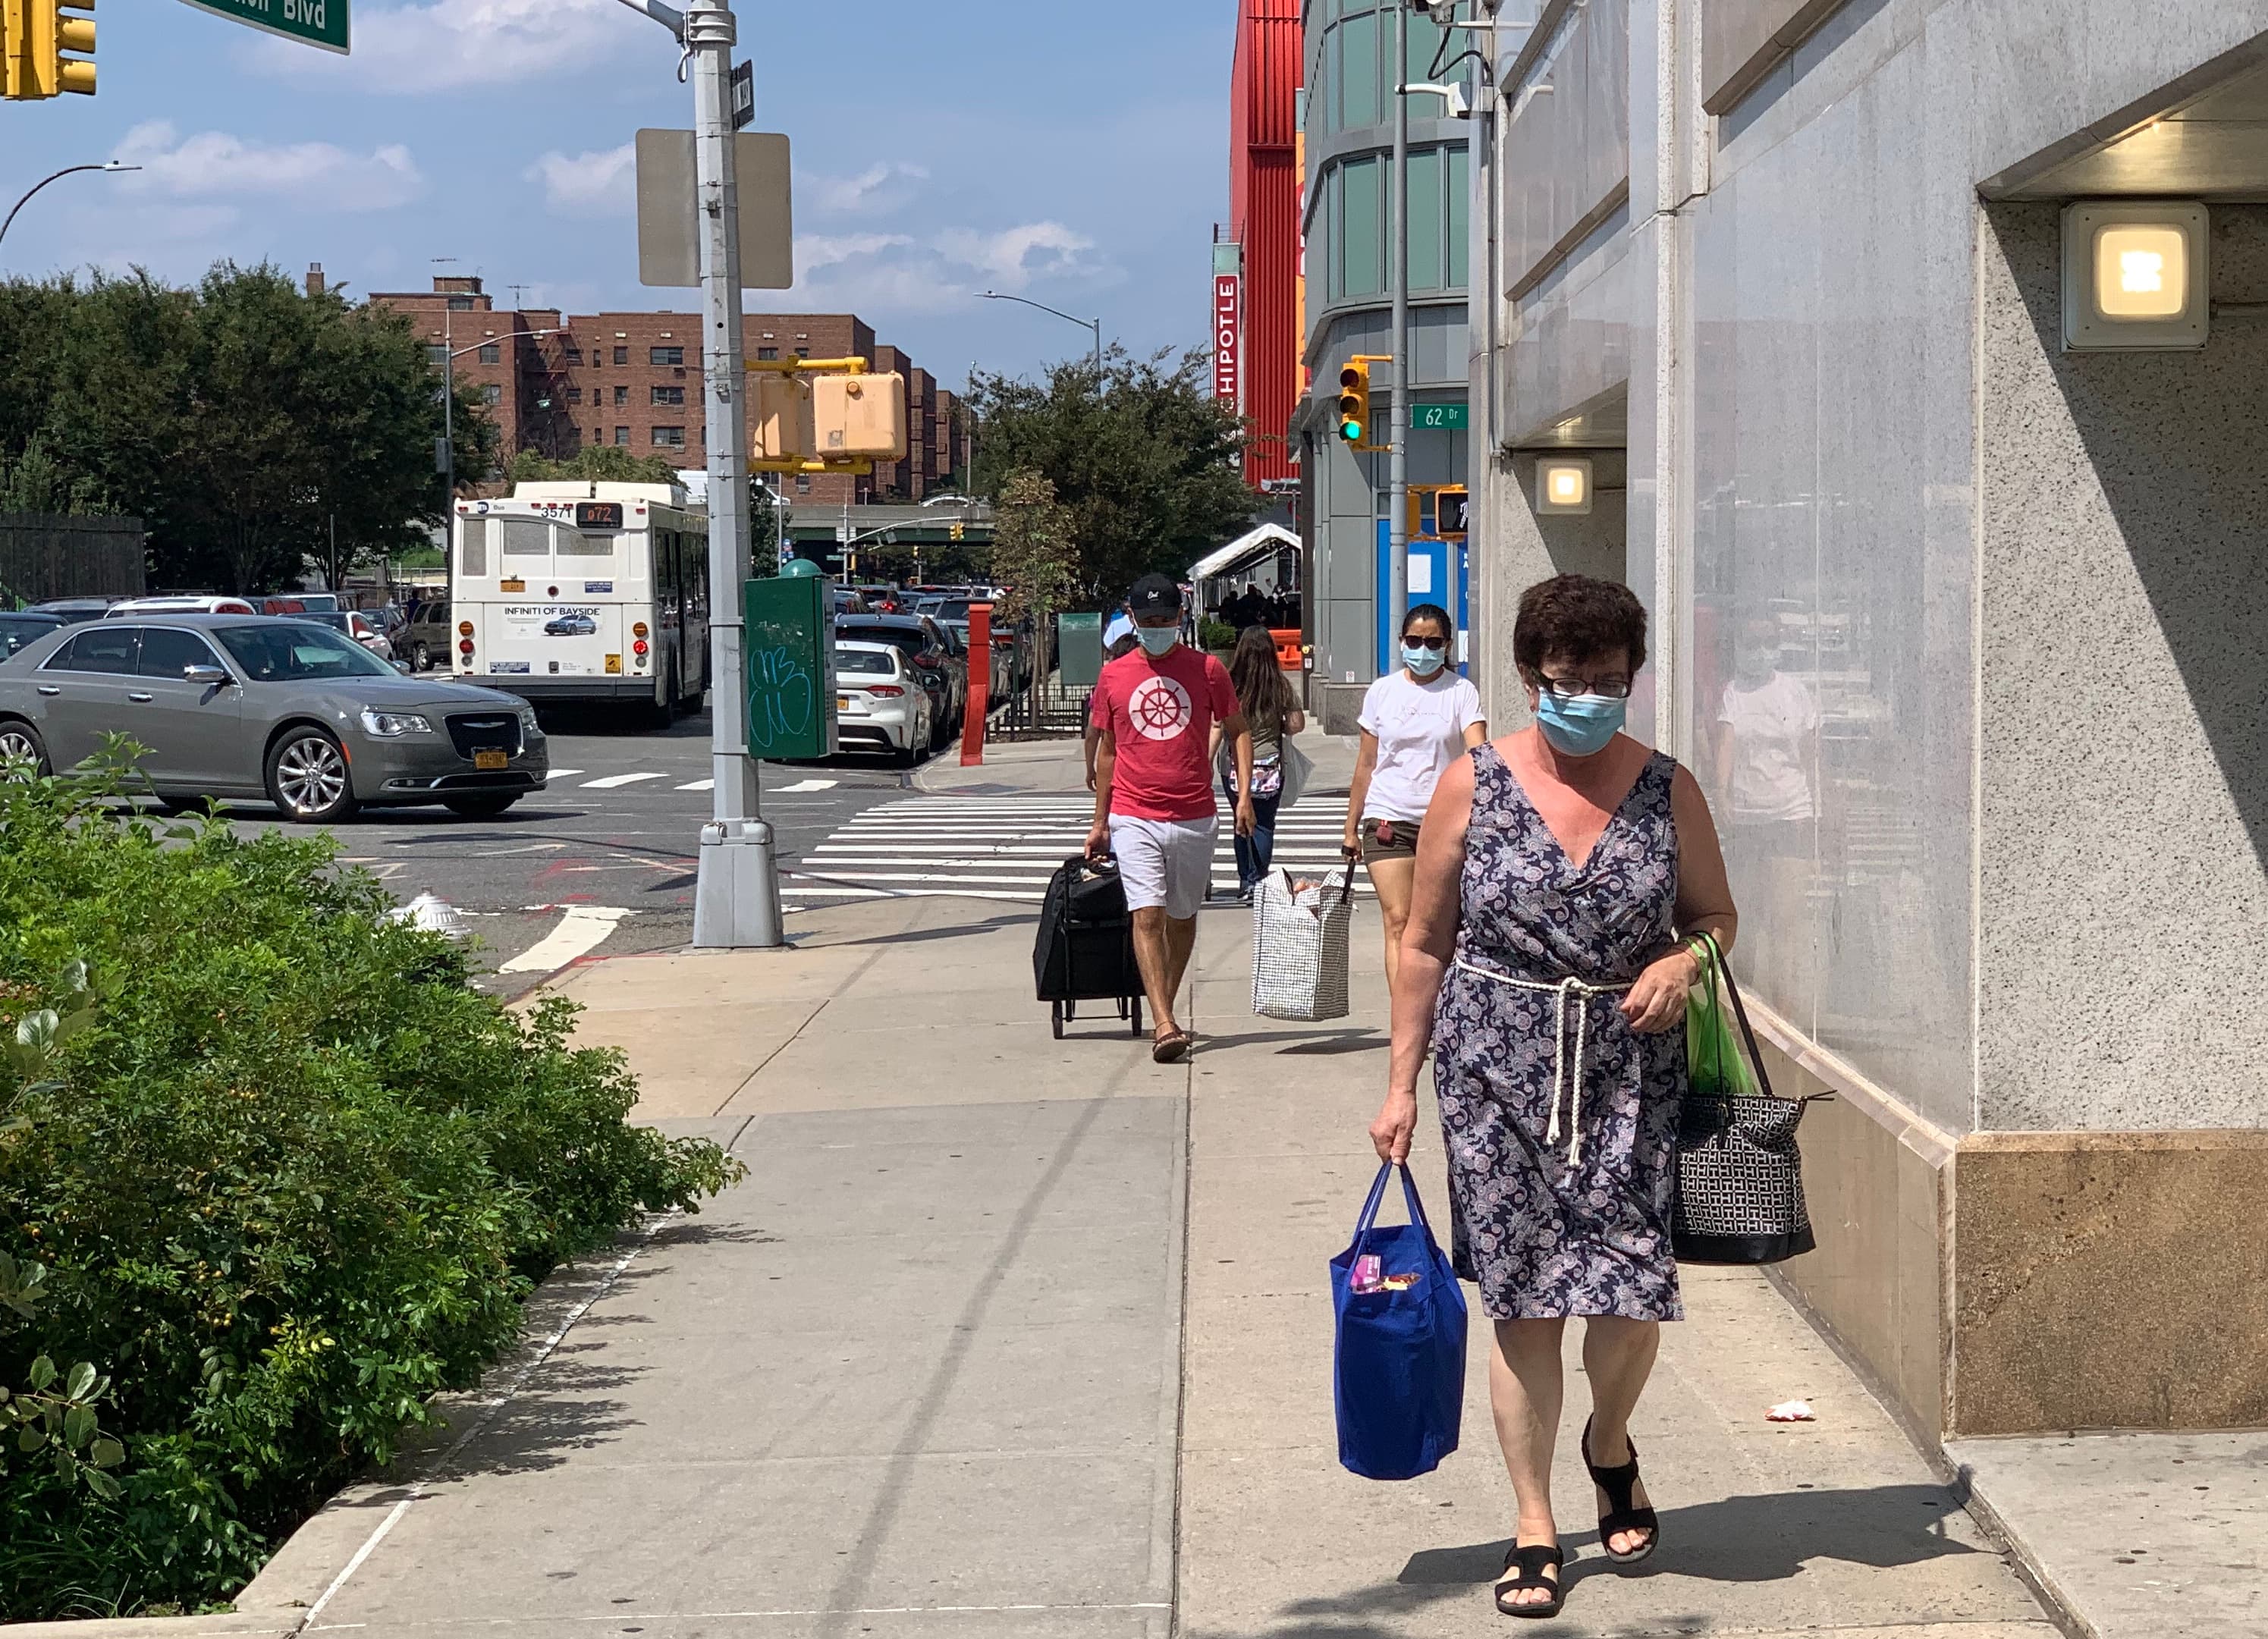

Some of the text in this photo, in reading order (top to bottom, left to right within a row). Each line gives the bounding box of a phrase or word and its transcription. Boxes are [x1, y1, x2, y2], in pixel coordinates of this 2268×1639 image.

[284, 0, 325, 30] Blvd
[1425, 408, 1459, 425] 62 Dr
[541, 507, 572, 519] 3571
[504, 607, 541, 615] INFINITI
[559, 608, 601, 616] BAYSIDE
